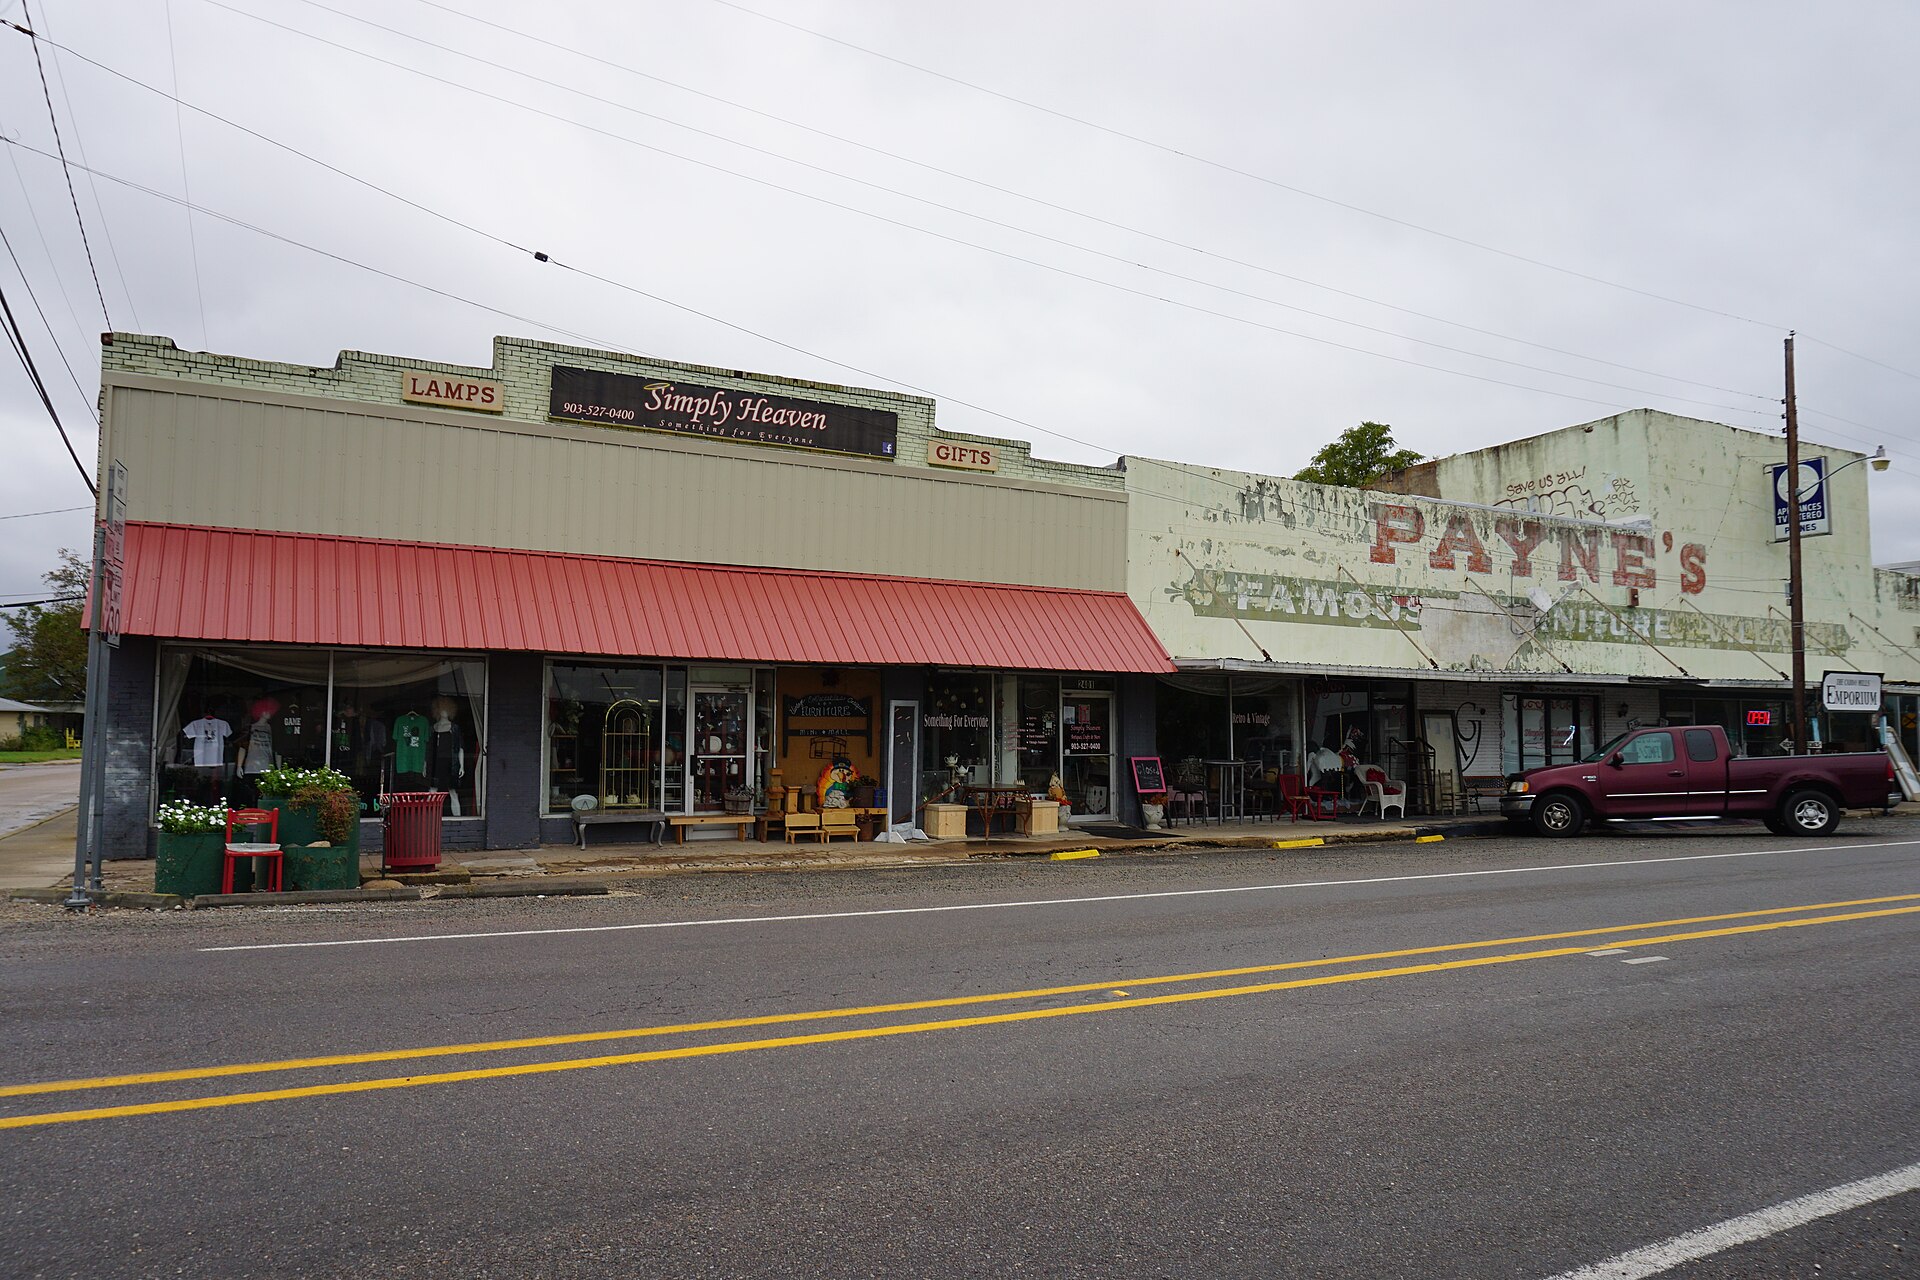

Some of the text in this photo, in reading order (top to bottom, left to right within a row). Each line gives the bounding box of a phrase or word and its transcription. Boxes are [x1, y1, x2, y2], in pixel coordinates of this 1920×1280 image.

[411, 377, 495, 403] LAMPS
[563, 402, 635, 421] 903-527-0400
[644, 386, 827, 430] Simply Heaven
[659, 419, 814, 444] Something for Everyone
[936, 445, 991, 465] GIFTS
[1777, 515, 1787, 523] TV
[1369, 504, 1707, 595] PAYNE'S
[109, 606, 120, 637] 30
[1827, 685, 1877, 705] EMPORIUM
[801, 705, 851, 717] FURNITURE
[1251, 712, 1271, 727] Vintage
[1747, 711, 1770, 725] OPEN
[284, 717, 302, 726] GAME
[923, 713, 989, 731] Something For Everyone
[1070, 742, 1101, 750] 903-527-0400
